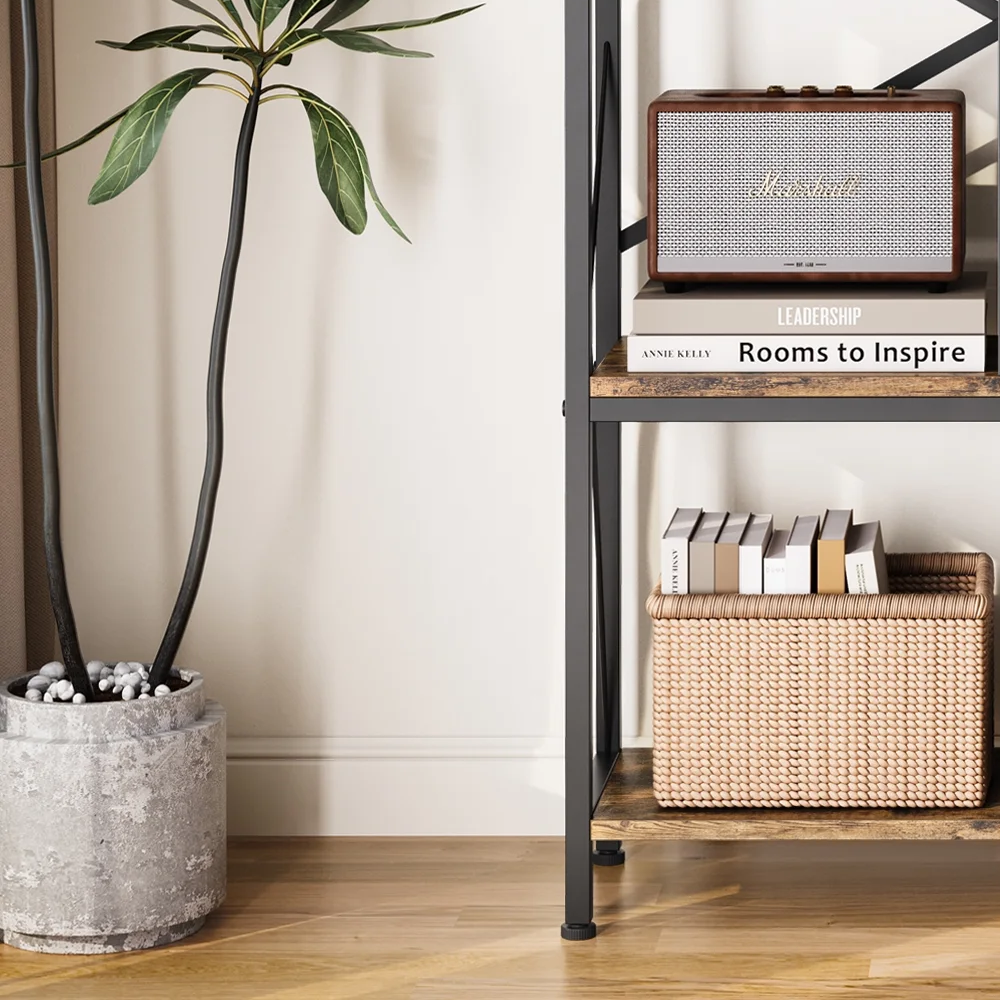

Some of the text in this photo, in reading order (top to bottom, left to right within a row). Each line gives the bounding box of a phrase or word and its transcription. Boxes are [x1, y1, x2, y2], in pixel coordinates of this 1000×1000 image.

[748, 168, 861, 198] Marshall
[777, 306, 862, 326] LEADERSHIP
[641, 349, 712, 359] ANNIE KELLY
[739, 341, 966, 369] Rooms to Inspire
[671, 549, 679, 573] ANNIE
